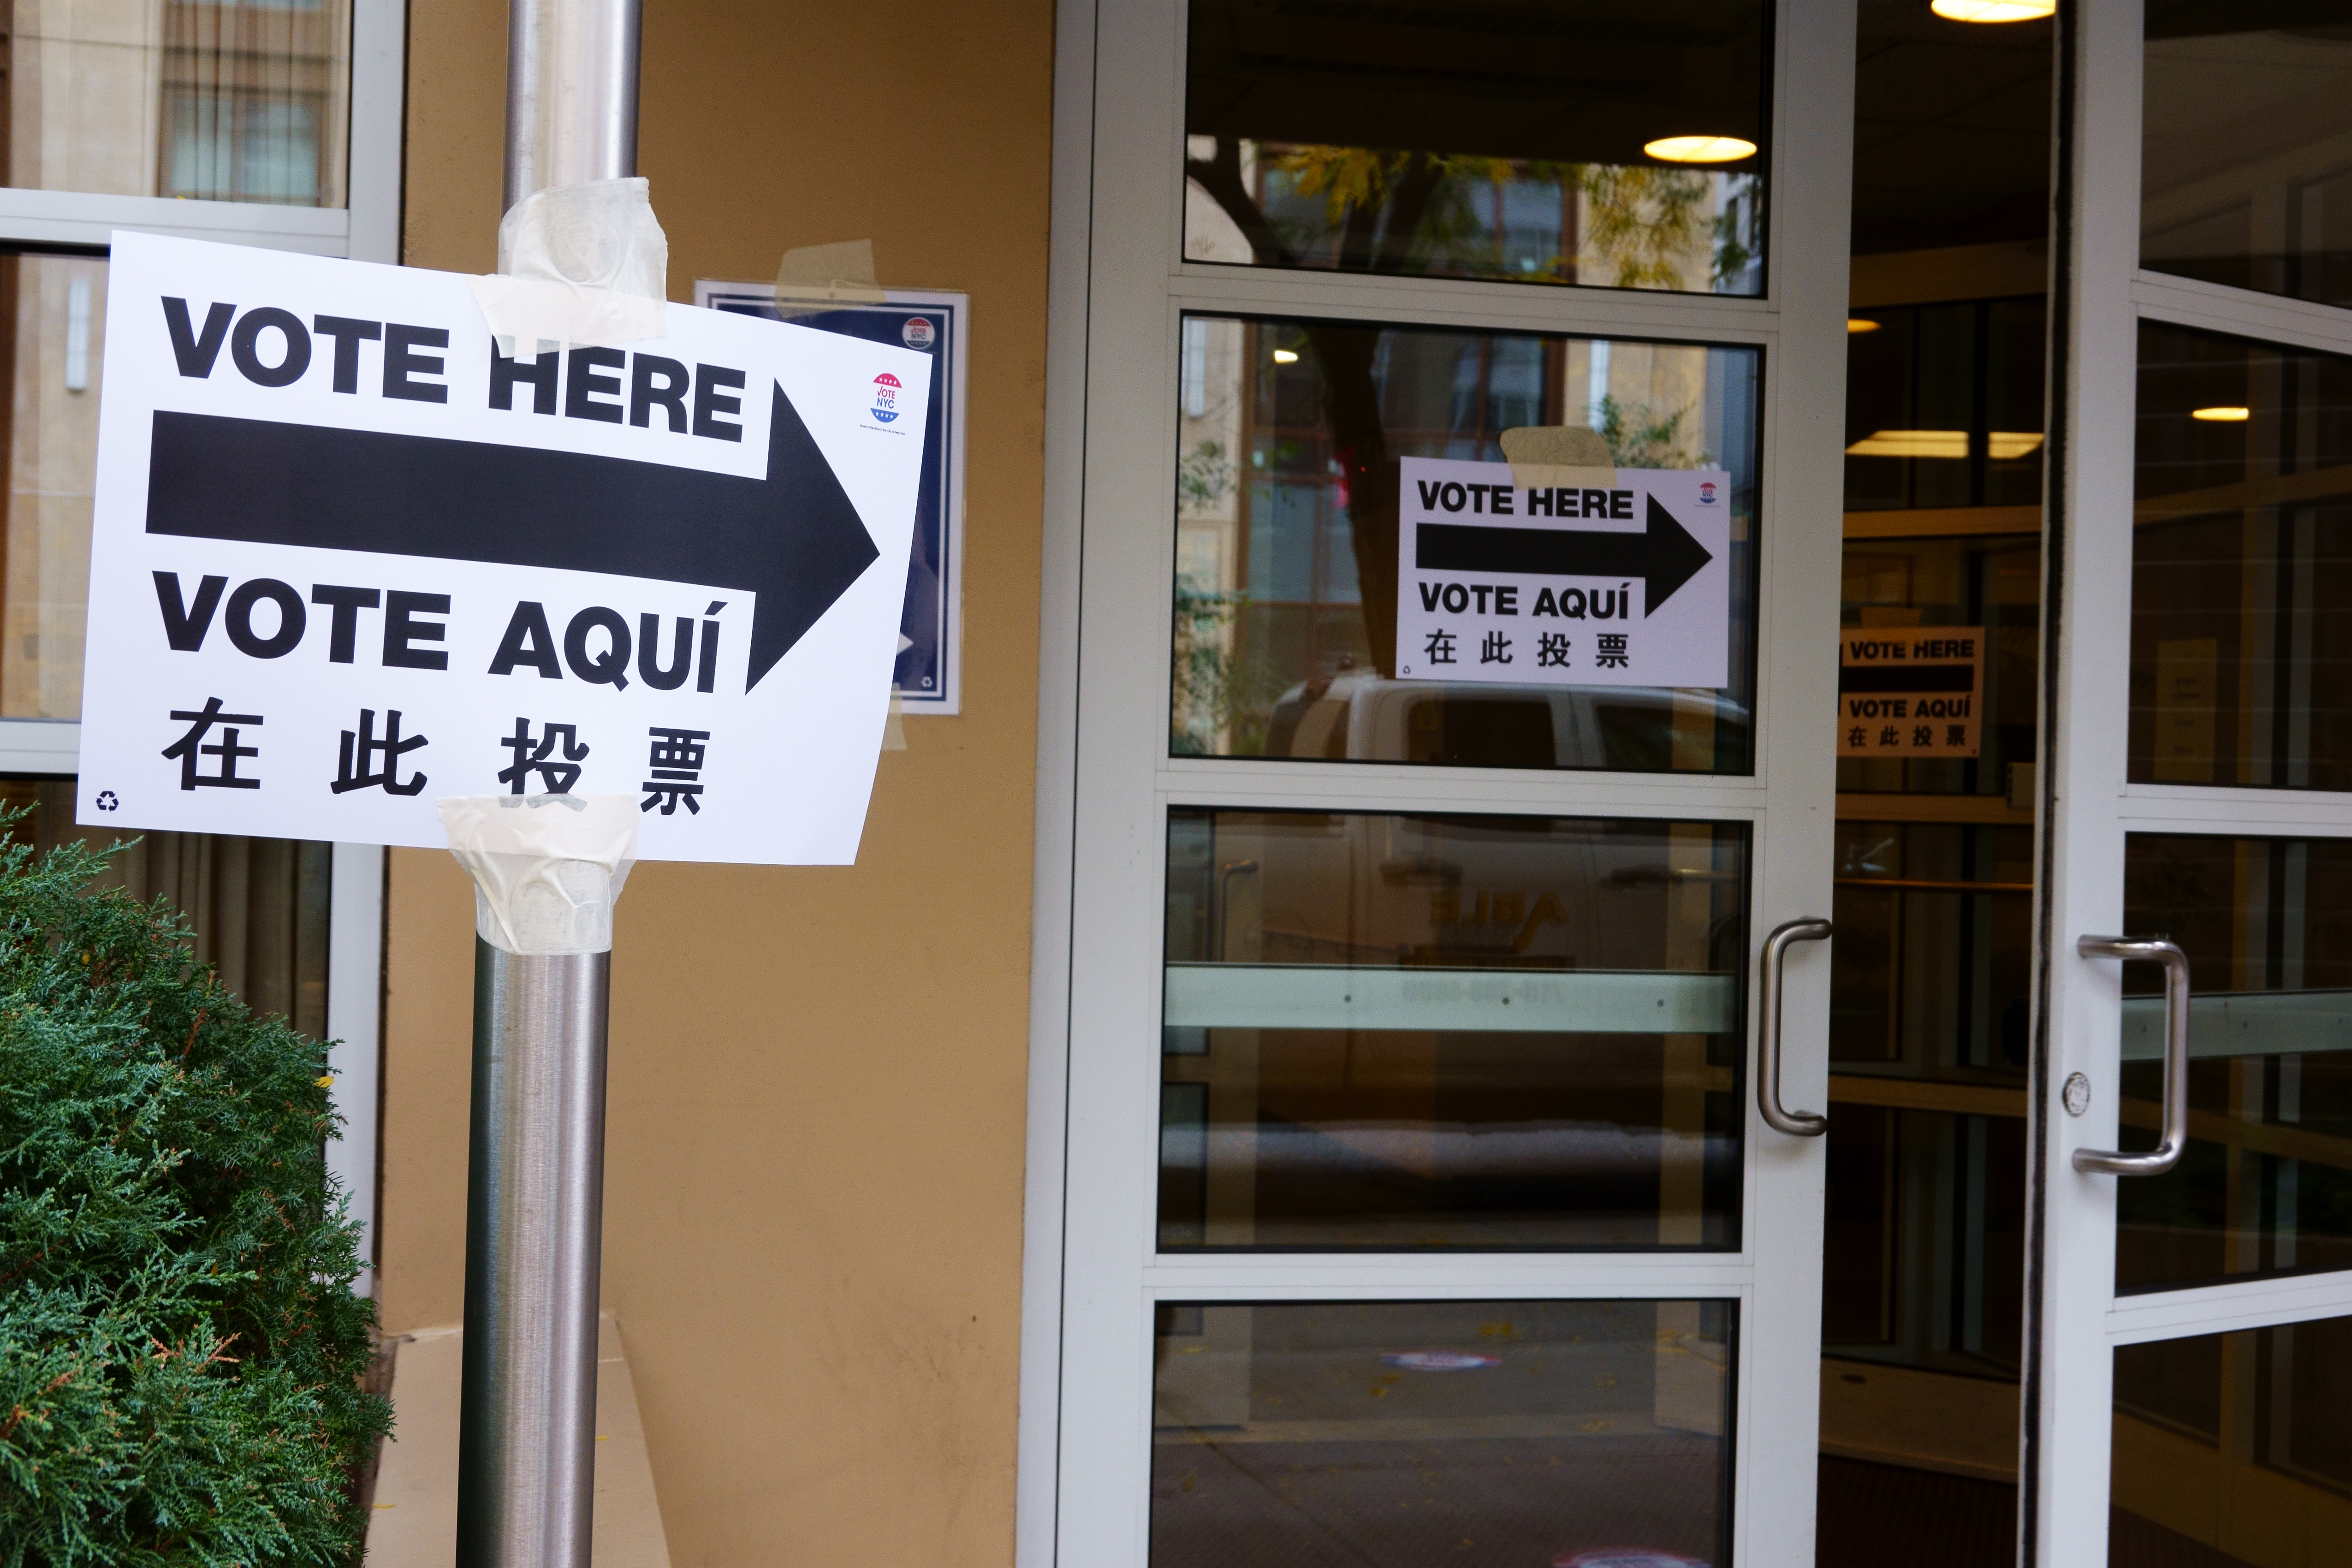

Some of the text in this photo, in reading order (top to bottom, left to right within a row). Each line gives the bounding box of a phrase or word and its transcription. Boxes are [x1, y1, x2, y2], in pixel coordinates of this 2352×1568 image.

[161, 296, 746, 443] VOTE HERE
[877, 386, 896, 399] VOTE
[877, 397, 894, 409] NYC
[1418, 480, 1633, 519] VOTE HERE
[1419, 582, 1630, 620] VOTE AQUÍ
[152, 570, 728, 693] VOTE AQUÍ
[1424, 629, 1629, 668] 在此投票
[1850, 639, 1975, 659] VOTE HERE
[1849, 695, 1972, 719] VOTE AQUÍ
[161, 696, 710, 815] 在此投票
[1848, 725, 1966, 748] 在此投票
